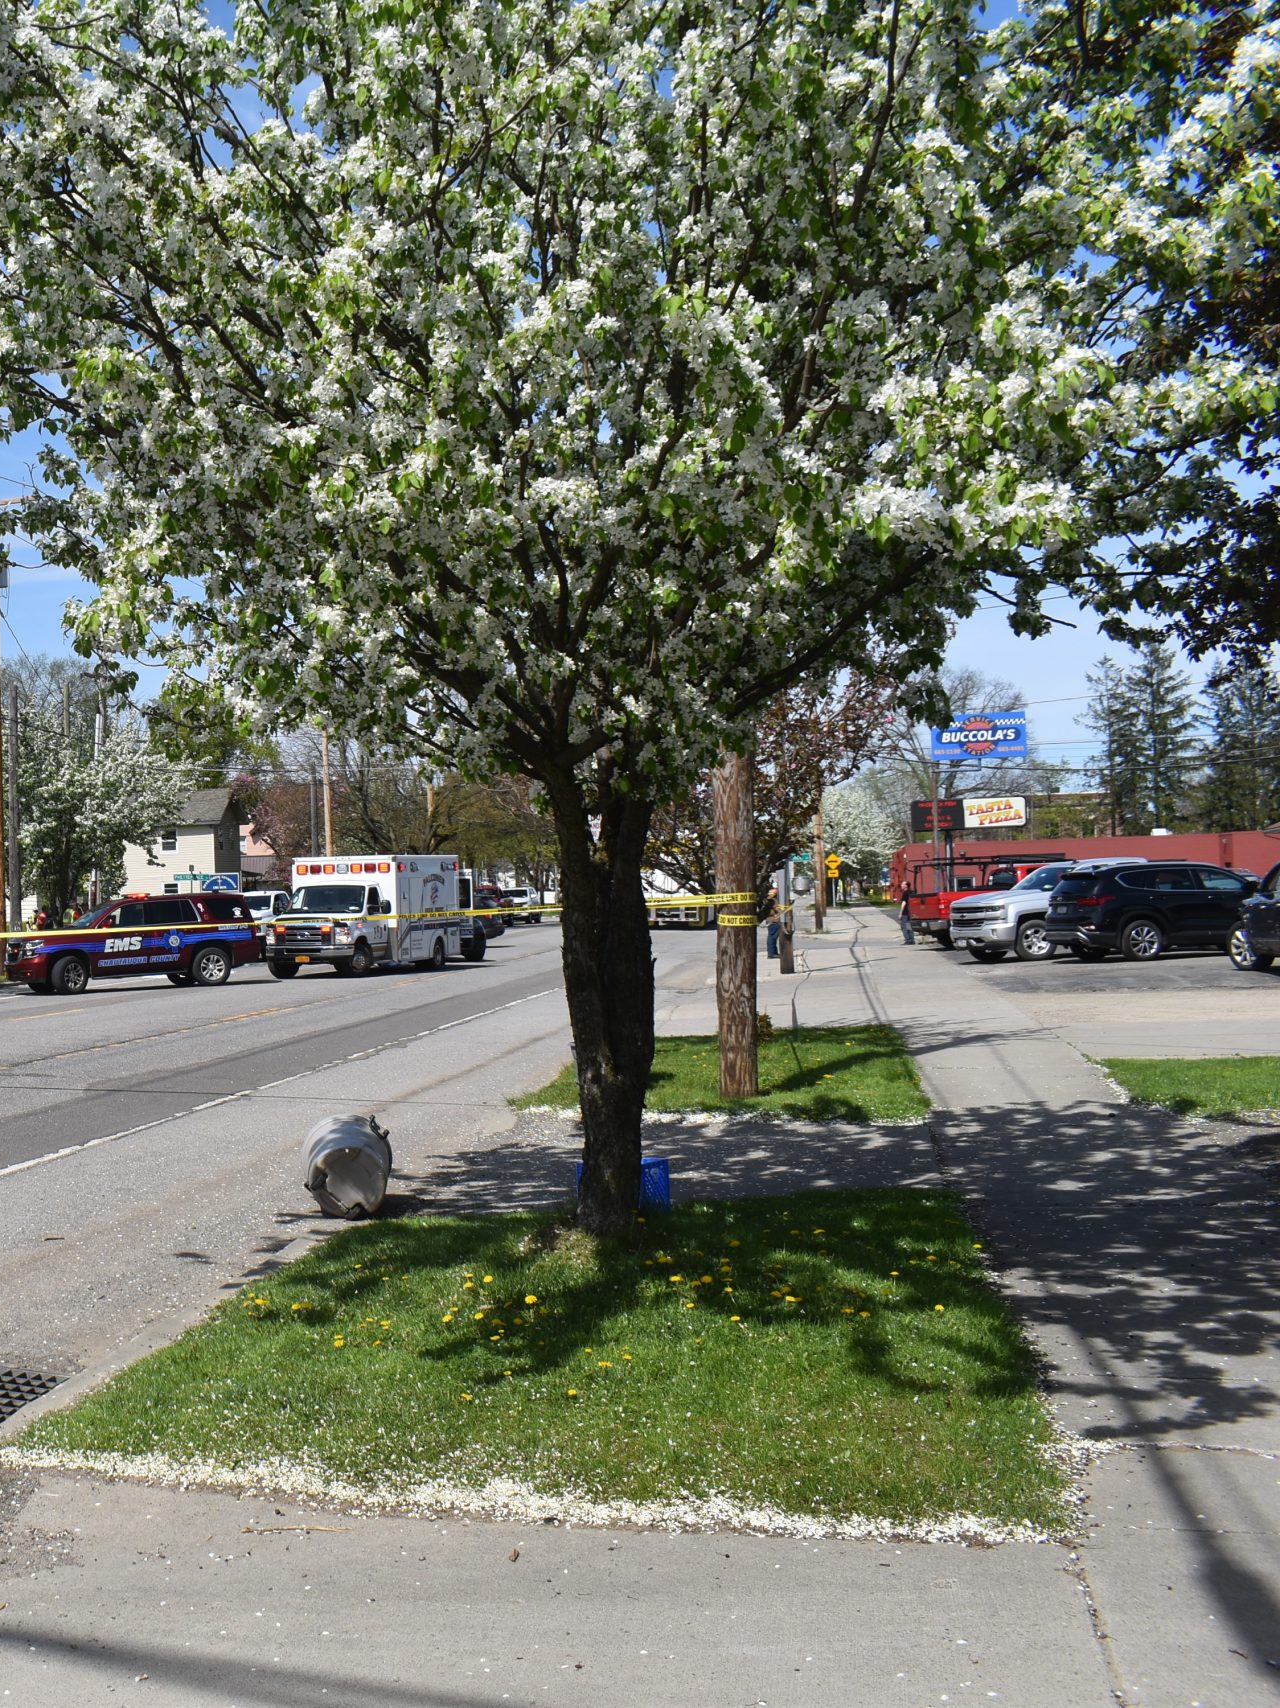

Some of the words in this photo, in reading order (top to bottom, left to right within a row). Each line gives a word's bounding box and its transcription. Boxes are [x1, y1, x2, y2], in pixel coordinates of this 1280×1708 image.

[961, 716, 996, 727] SERVICE
[942, 729, 1015, 743] BUCCOLA'S
[962, 744, 996, 756] STATION
[966, 799, 1014, 816] TASTA
[978, 809, 1024, 826] PIZZA
[740, 894, 748, 902] DO
[720, 916, 726, 924] DO
[104, 936, 143, 953] EMS
[98, 956, 147, 967] CHAUTAUQUA
[149, 954, 180, 963] COUNTY
